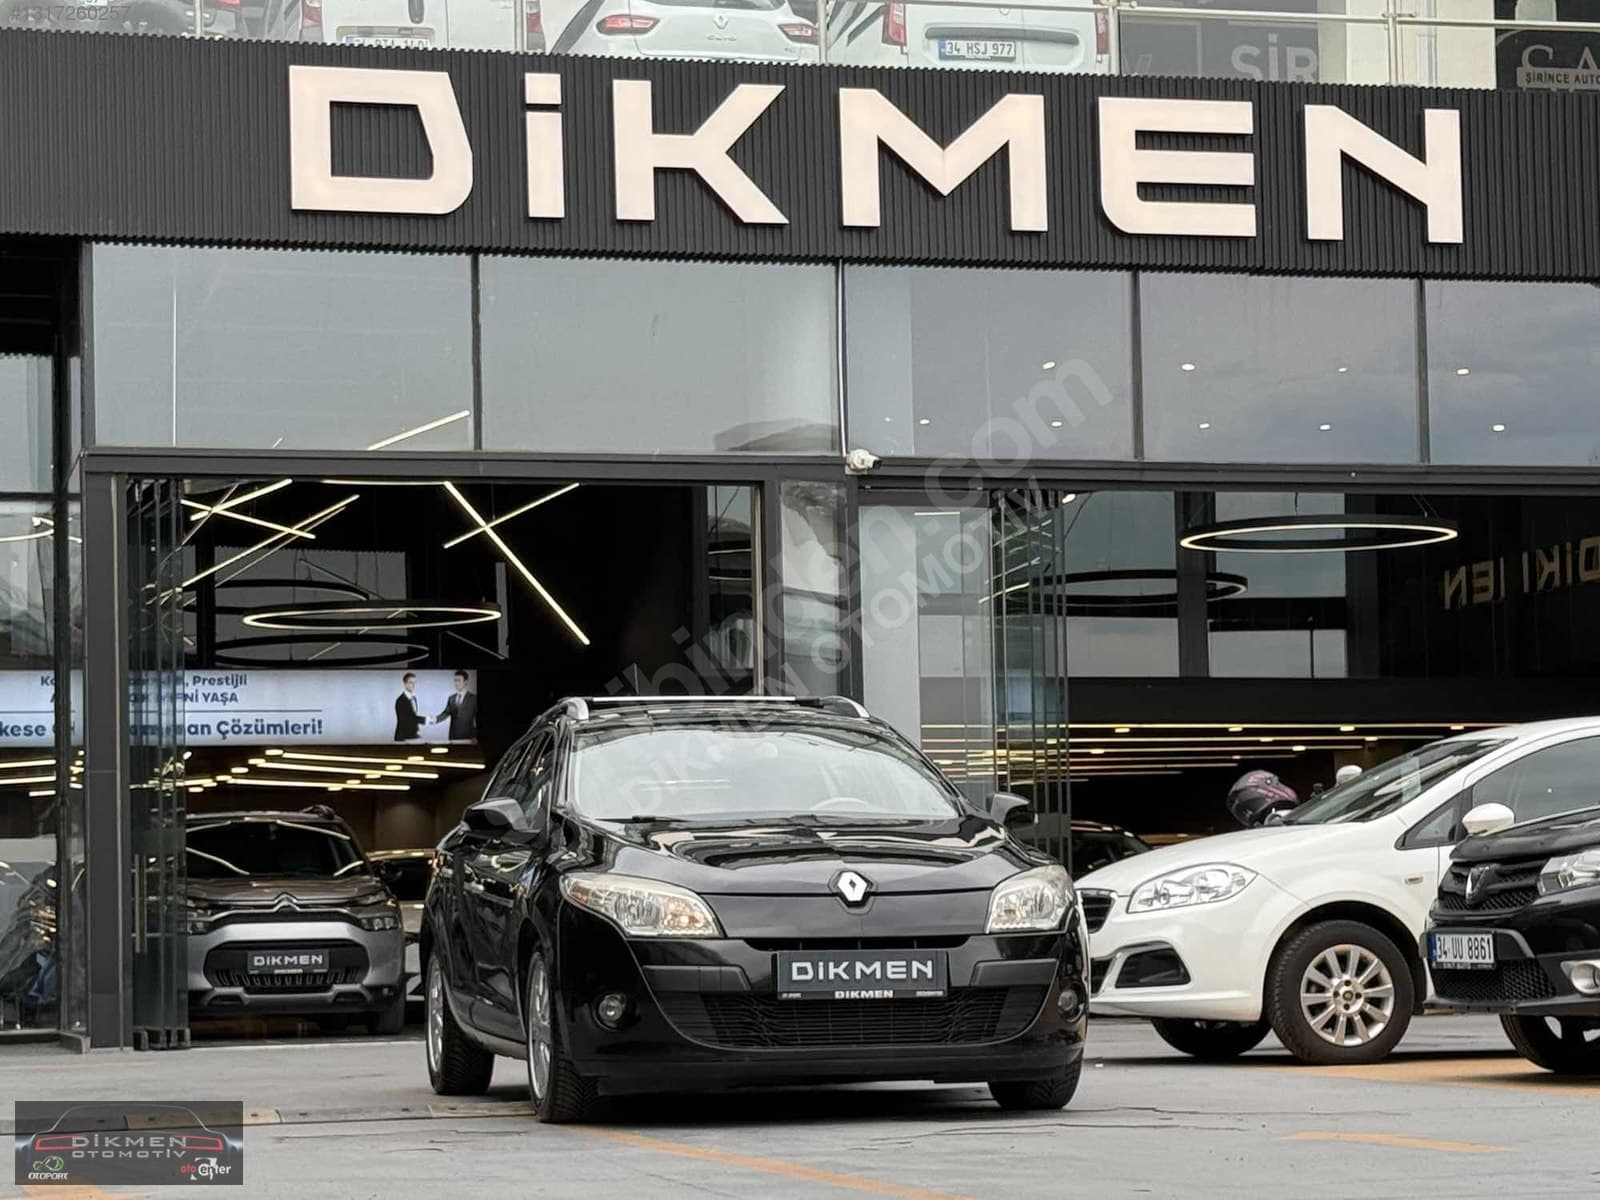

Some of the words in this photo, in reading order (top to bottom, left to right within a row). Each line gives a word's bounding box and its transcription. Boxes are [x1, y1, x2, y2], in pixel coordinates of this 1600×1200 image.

[947, 42, 960, 54] 34
[966, 42, 987, 55] HSJ
[992, 43, 1013, 55] 977
[192, 674, 247, 688] Prestijli
[202, 691, 239, 706] YAŞA
[216, 718, 323, 740] Çözümleri!
[1437, 936, 1448, 959] 34
[1467, 937, 1492, 961] 8861
